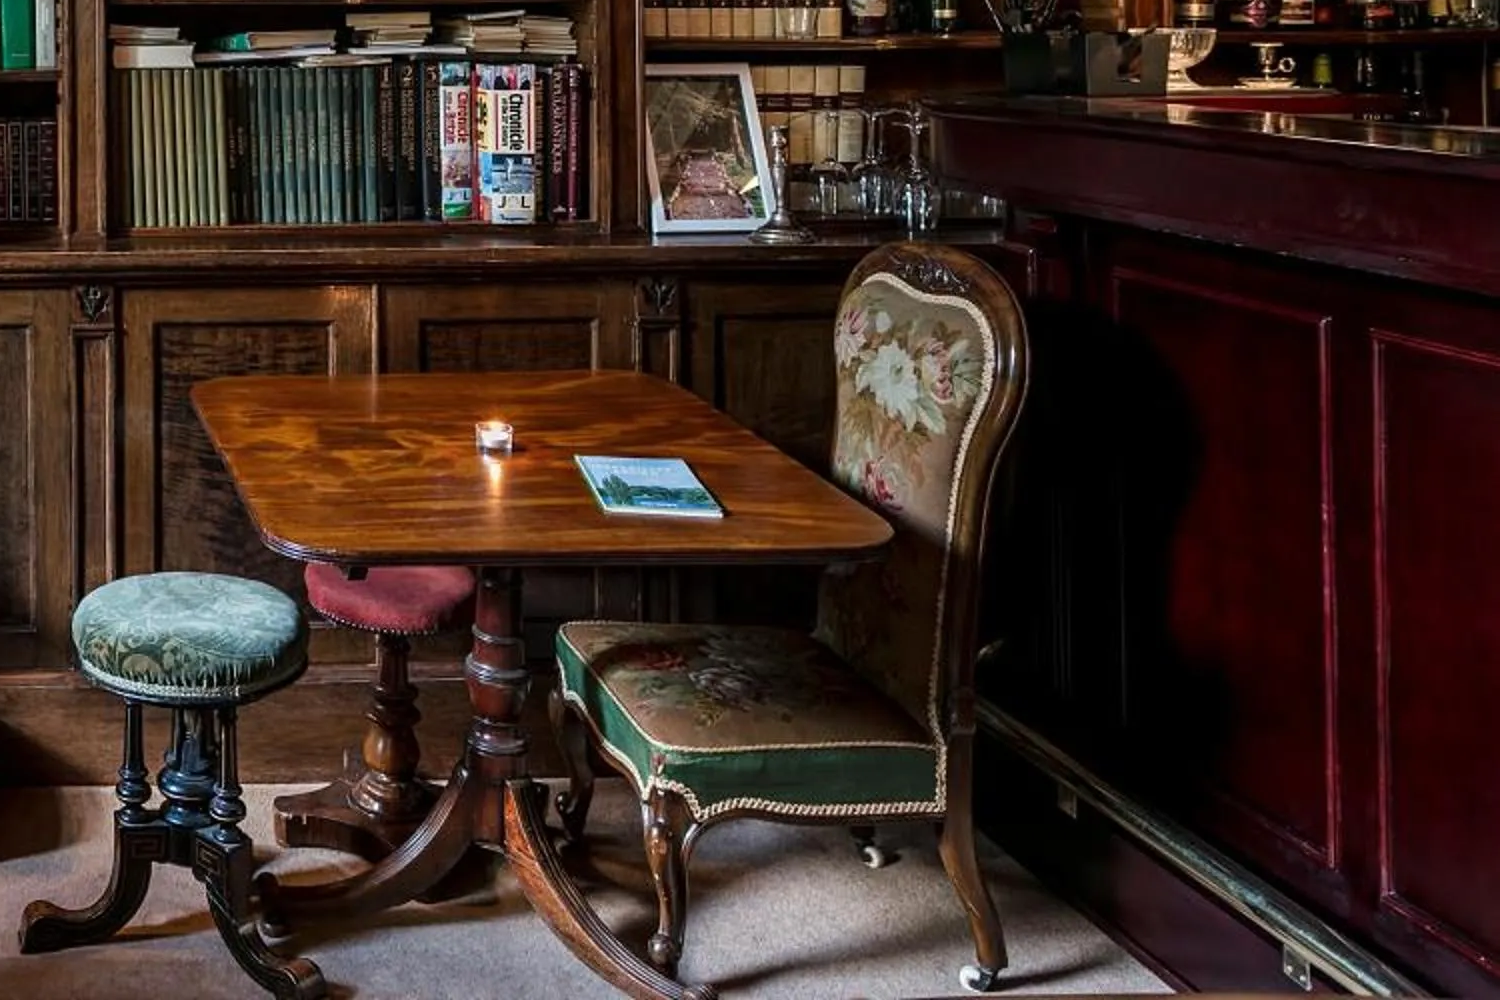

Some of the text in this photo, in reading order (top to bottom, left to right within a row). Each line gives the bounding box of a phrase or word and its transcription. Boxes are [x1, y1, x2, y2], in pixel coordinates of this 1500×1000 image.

[457, 91, 469, 144] Chronicle
[509, 93, 525, 151] Chronicle
[552, 71, 563, 174] POPULAR ANTIQUES
